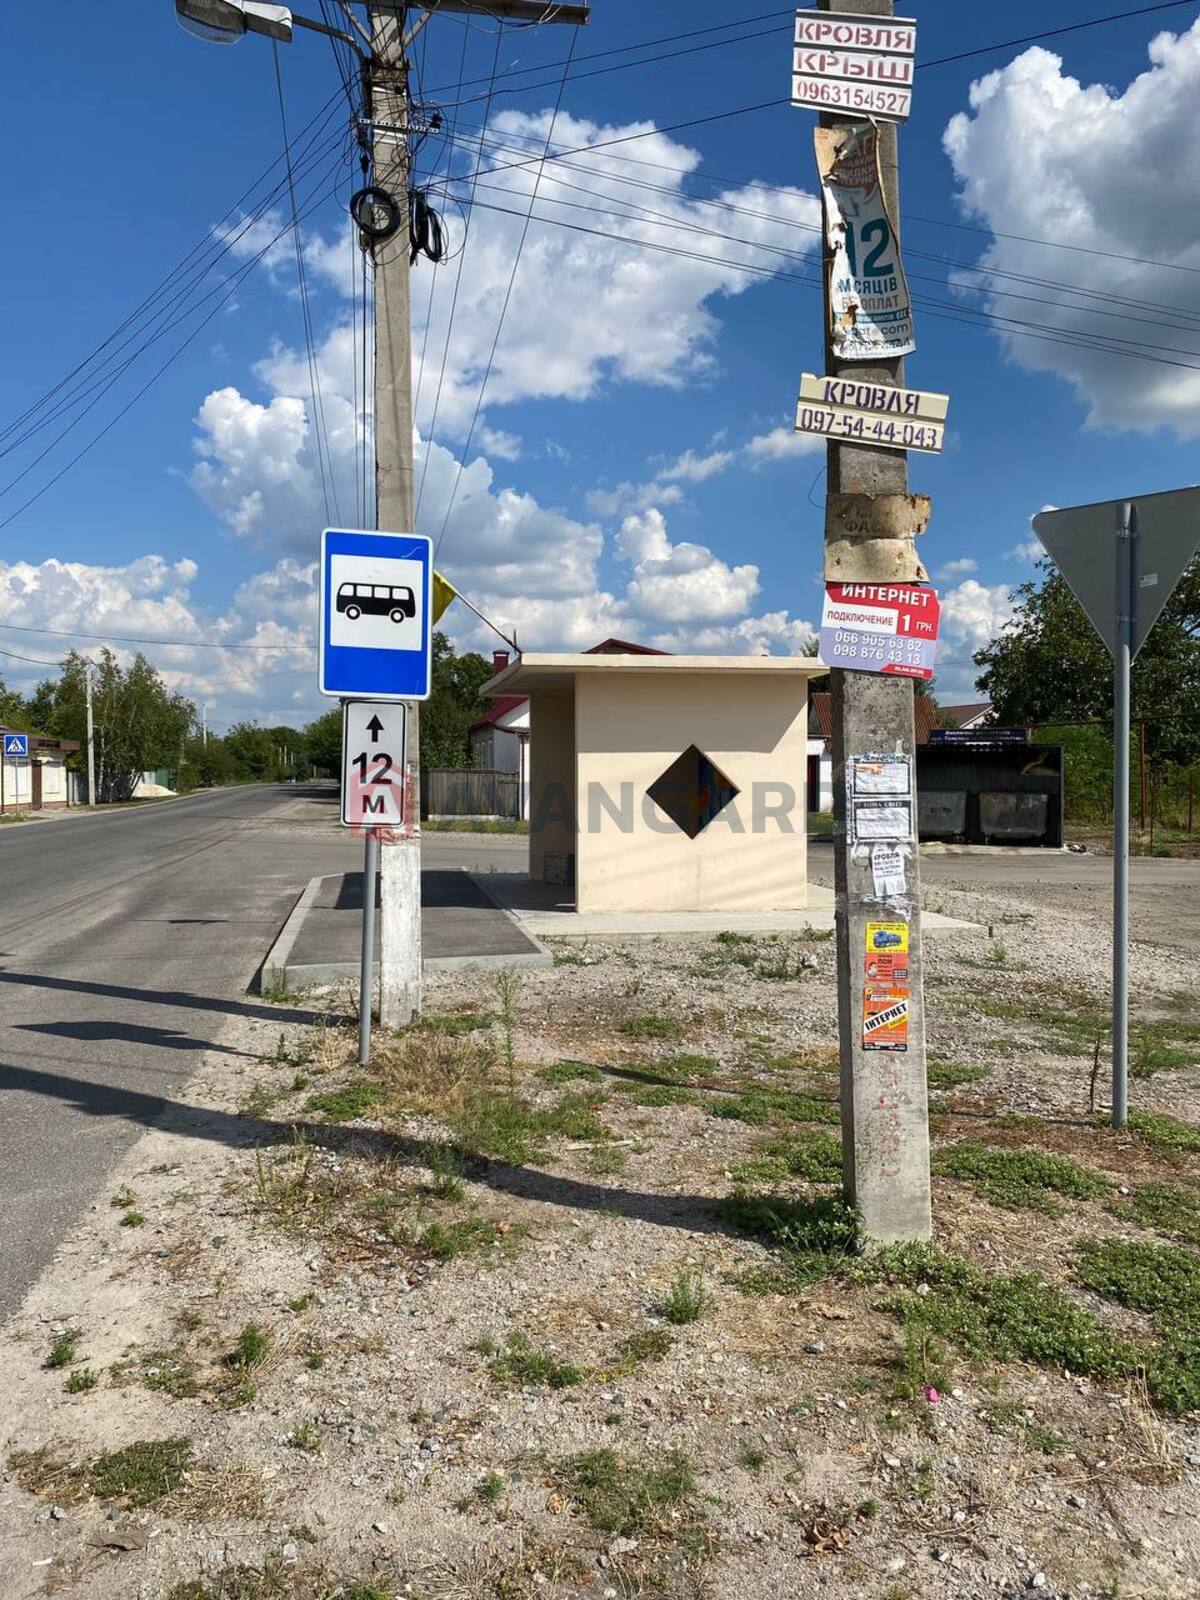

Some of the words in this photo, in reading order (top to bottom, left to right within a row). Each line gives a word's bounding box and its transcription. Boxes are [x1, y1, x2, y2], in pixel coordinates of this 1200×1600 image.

[799, 22, 912, 49] КРОВЛЯ
[797, 53, 910, 81] КРЫШ
[797, 81, 909, 113] 0963154527
[845, 218, 894, 277] 12
[824, 381, 920, 415] КРОВЛЯ
[801, 408, 937, 449] 097-54-44-043
[841, 584, 930, 607] ИНТЕРНЕТ
[827, 610, 894, 626] ПОДКЛЮЧЕНИЕ
[902, 614, 912, 632] 1
[834, 644, 857, 657] 098
[862, 647, 884, 660] 876
[887, 650, 904, 663] 43
[907, 653, 921, 665] 13
[835, 631, 858, 643] 066
[862, 633, 886, 647] 905
[889, 637, 904, 649] 63
[907, 640, 922, 652] 82
[352, 752, 393, 784] 12
[864, 1003, 908, 1030] ІНТЕРНЕТ
